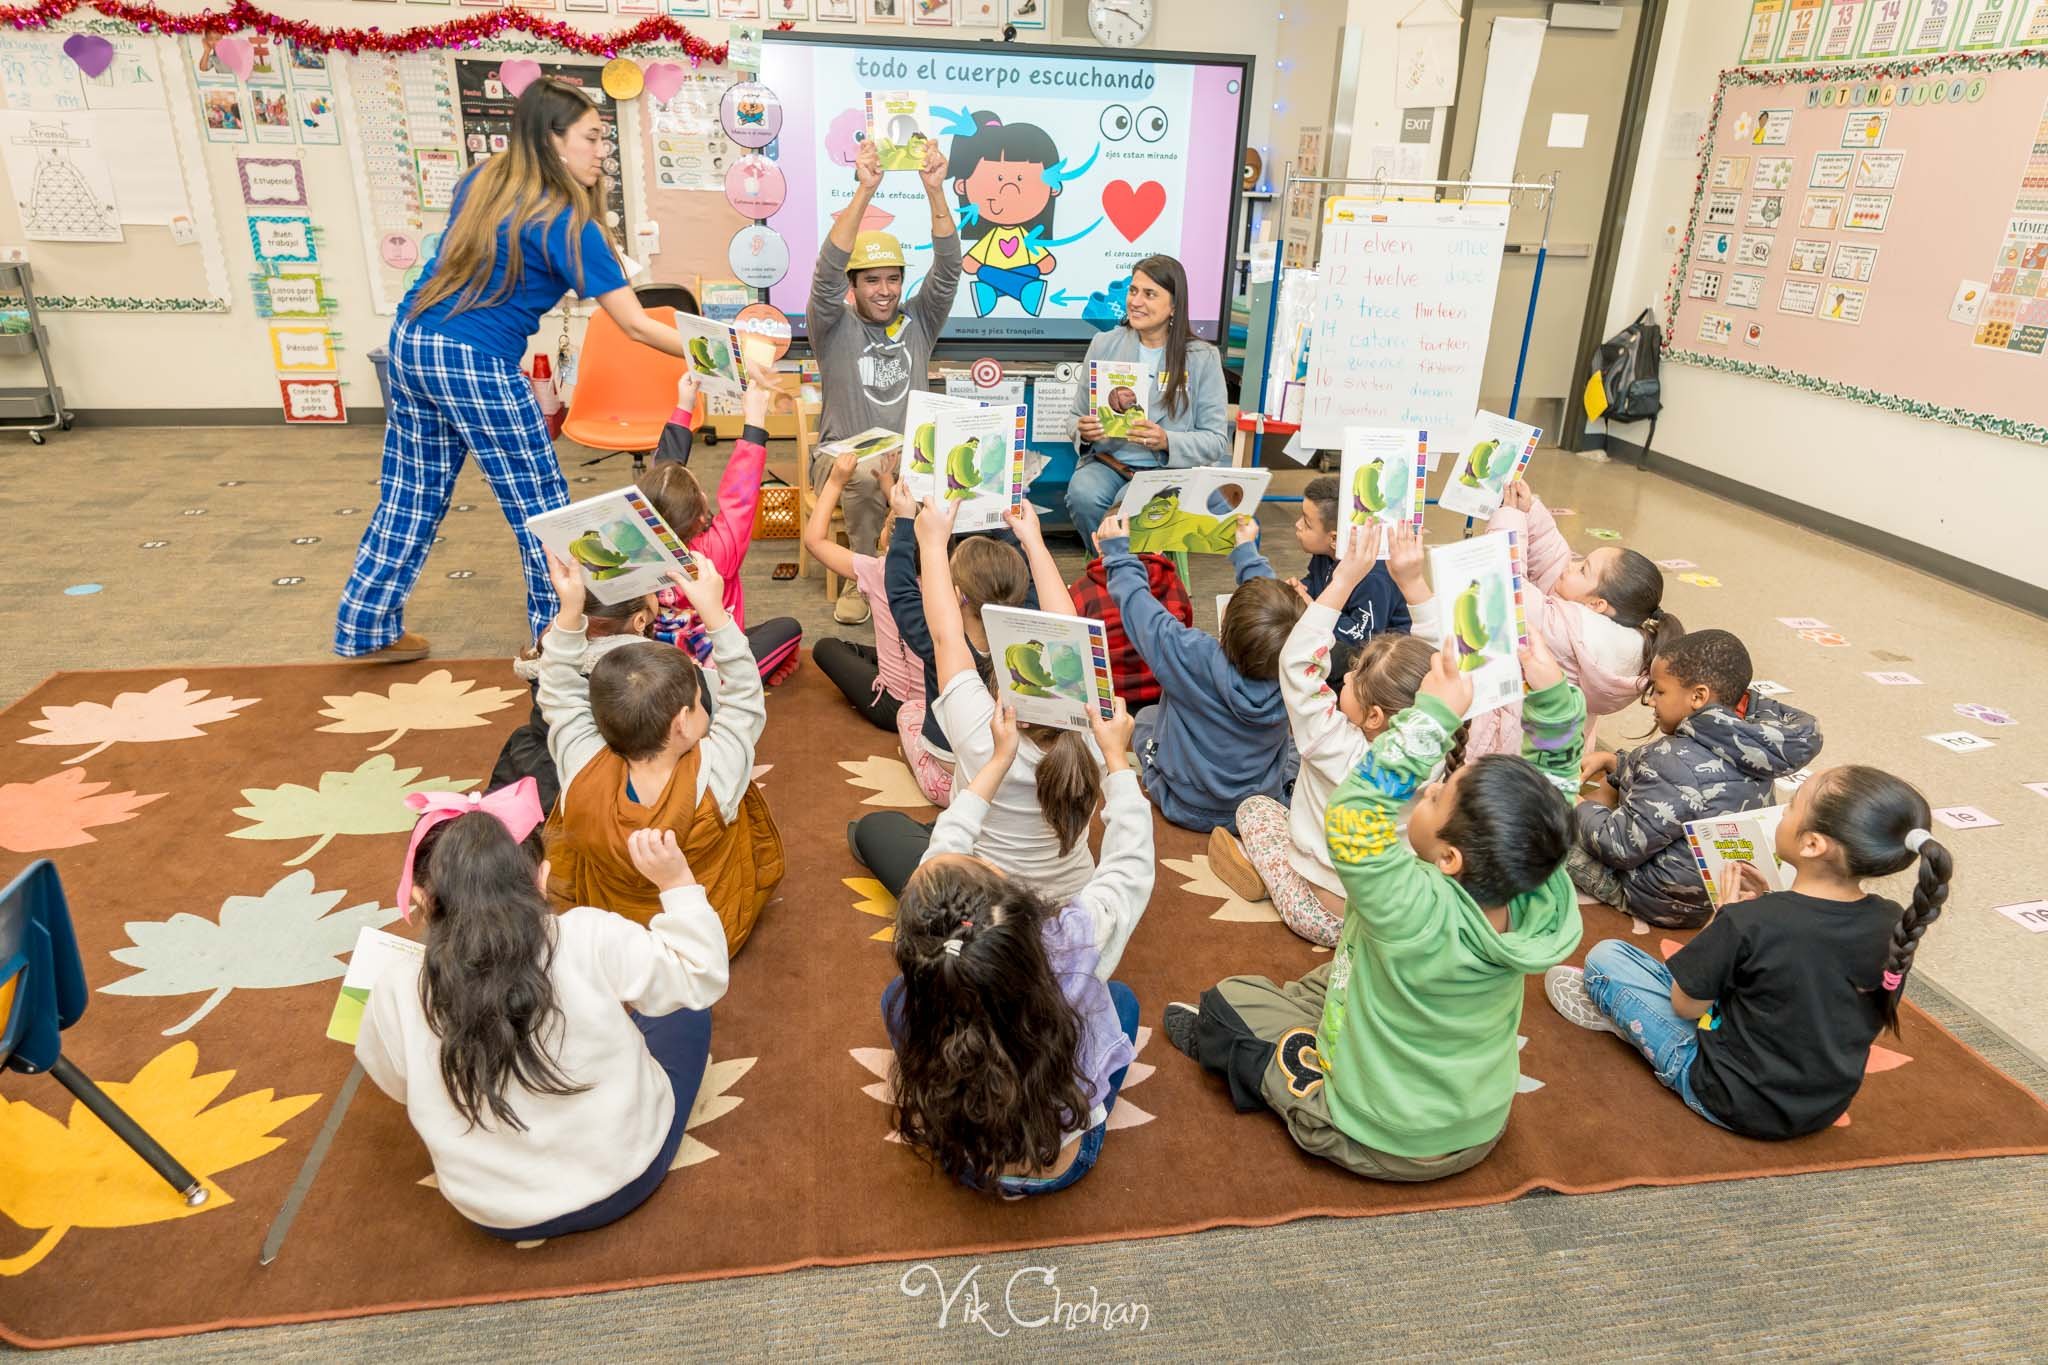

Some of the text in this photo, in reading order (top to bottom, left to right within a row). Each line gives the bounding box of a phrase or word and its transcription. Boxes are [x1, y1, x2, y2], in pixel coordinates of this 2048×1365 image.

[1837, 6, 1855, 26] 13
[1881, 1, 1900, 22] 14
[1930, 0, 1949, 16] 15
[1757, 14, 1772, 32] 11
[1796, 10, 1814, 29] 12
[856, 56, 1155, 90] todo el cuerpo escuchando
[490, 84, 498, 95] 6
[1405, 119, 1431, 130] EXIT
[1147, 151, 1178, 160] mirando
[831, 189, 840, 197] El
[889, 191, 925, 199] enfocado
[865, 243, 881, 252] DO
[1333, 231, 1349, 254] 11
[1363, 231, 1414, 255] elven
[1717, 235, 1728, 253] 6
[1755, 245, 1767, 255] six
[1328, 265, 1347, 287] 12
[1363, 263, 1419, 288] twelve
[1323, 293, 1344, 312] 13
[1359, 296, 1401, 319] trece
[988, 328, 1004, 336] pies
[1321, 319, 1337, 337] 14
[1316, 367, 1334, 386] 16
[1314, 396, 1332, 416] 17
[1945, 811, 1977, 823] te
